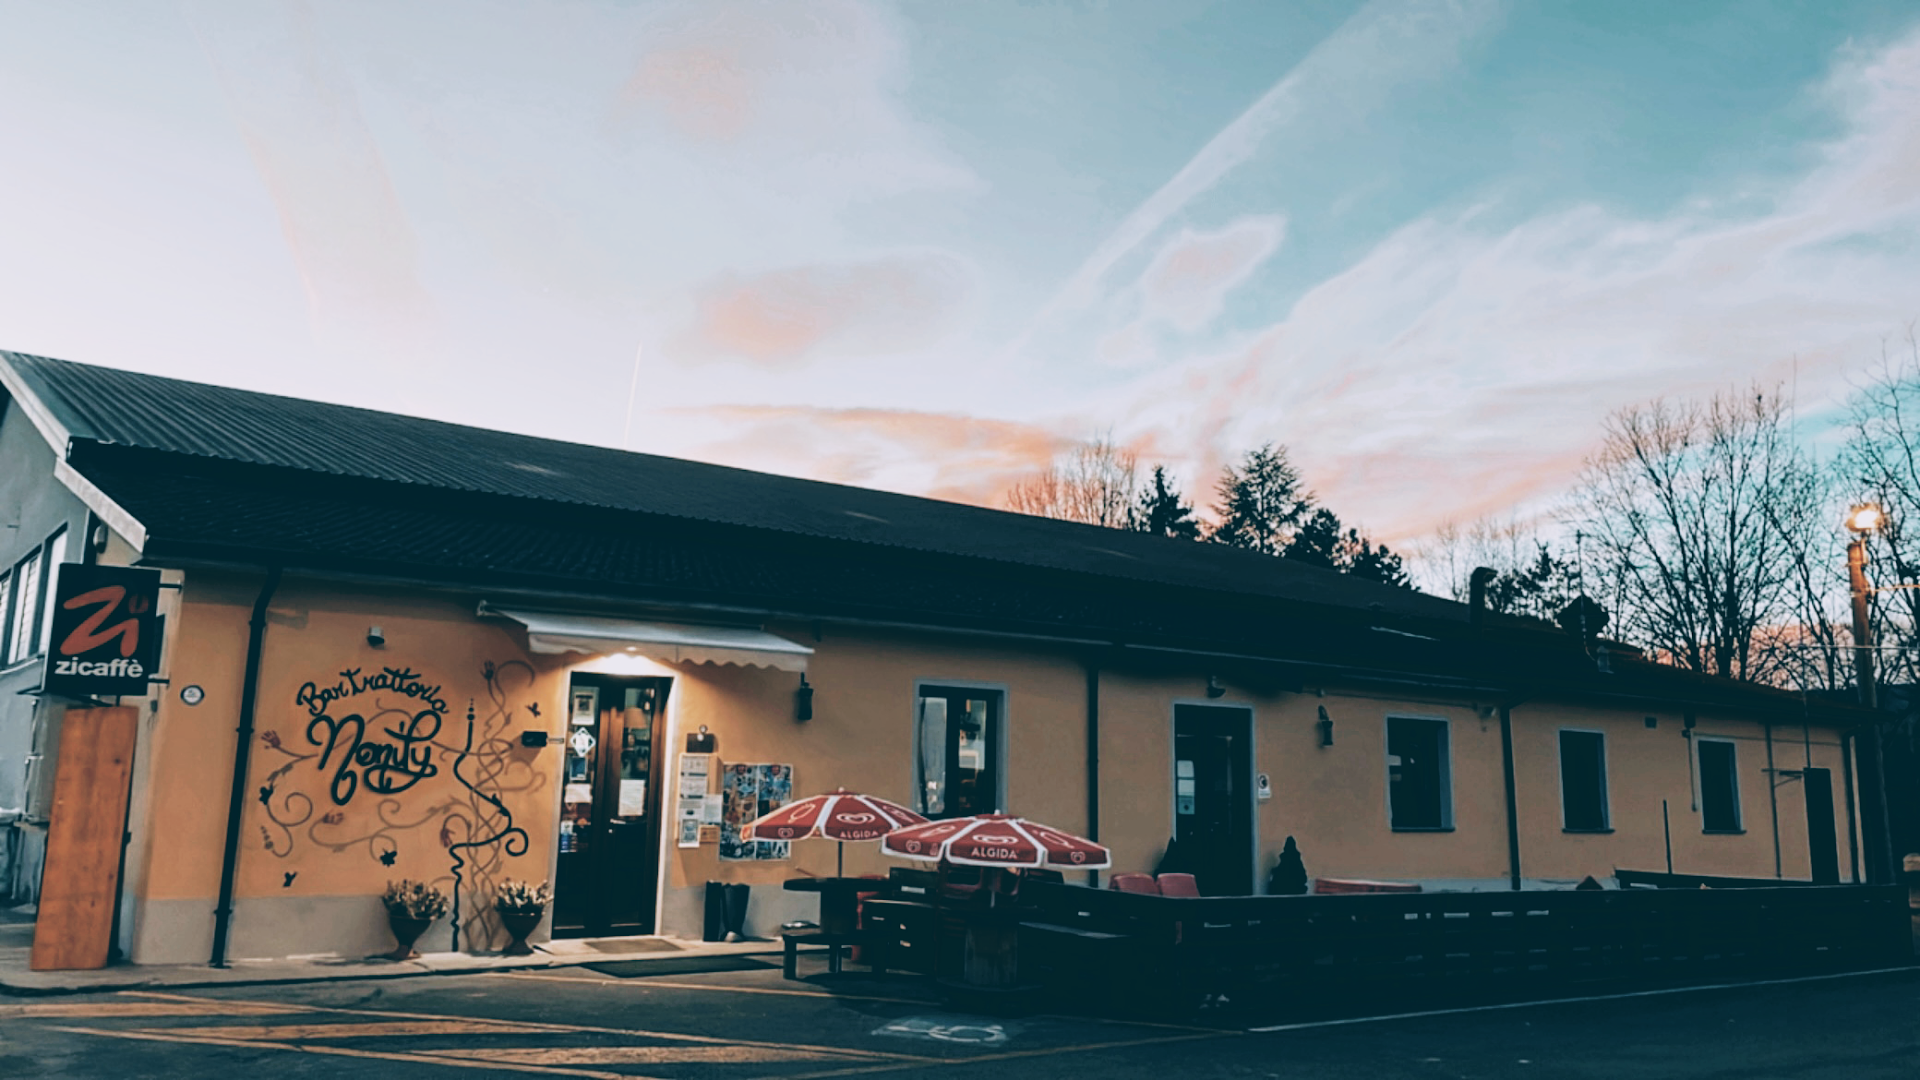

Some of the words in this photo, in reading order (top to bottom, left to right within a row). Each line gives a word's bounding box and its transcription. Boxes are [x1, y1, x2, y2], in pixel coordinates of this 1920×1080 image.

[54, 656, 144, 678] zicaffè
[296, 681, 349, 717] Bar
[839, 830, 879, 840] ALGIDA
[971, 846, 1018, 860] ALGIDA
